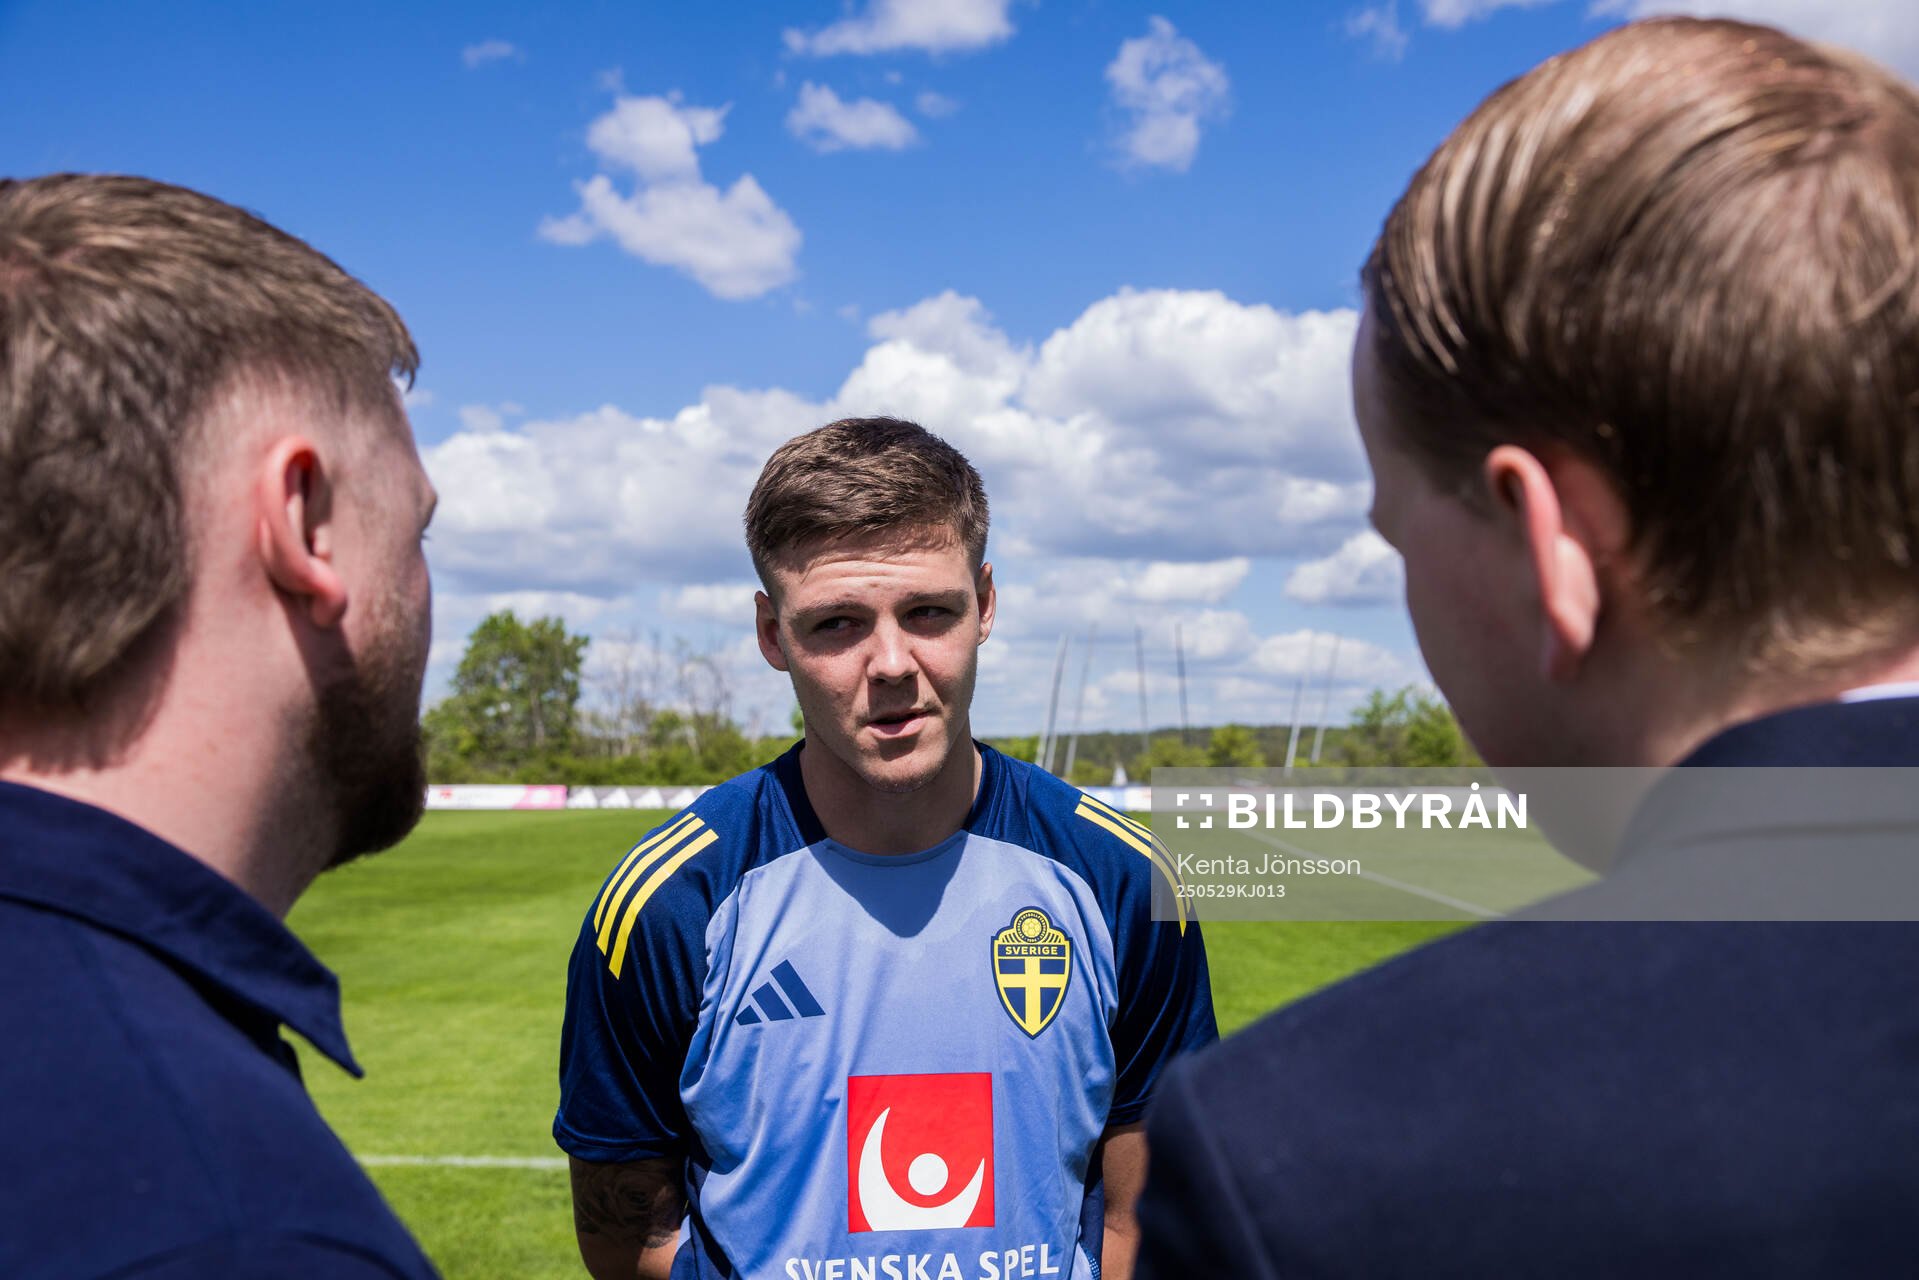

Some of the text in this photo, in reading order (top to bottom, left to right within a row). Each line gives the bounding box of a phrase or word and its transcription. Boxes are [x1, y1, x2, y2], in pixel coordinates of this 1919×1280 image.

[1005, 946, 1058, 955] SVERIGE
[785, 1243, 1060, 1280] SVENSKA SPEL
